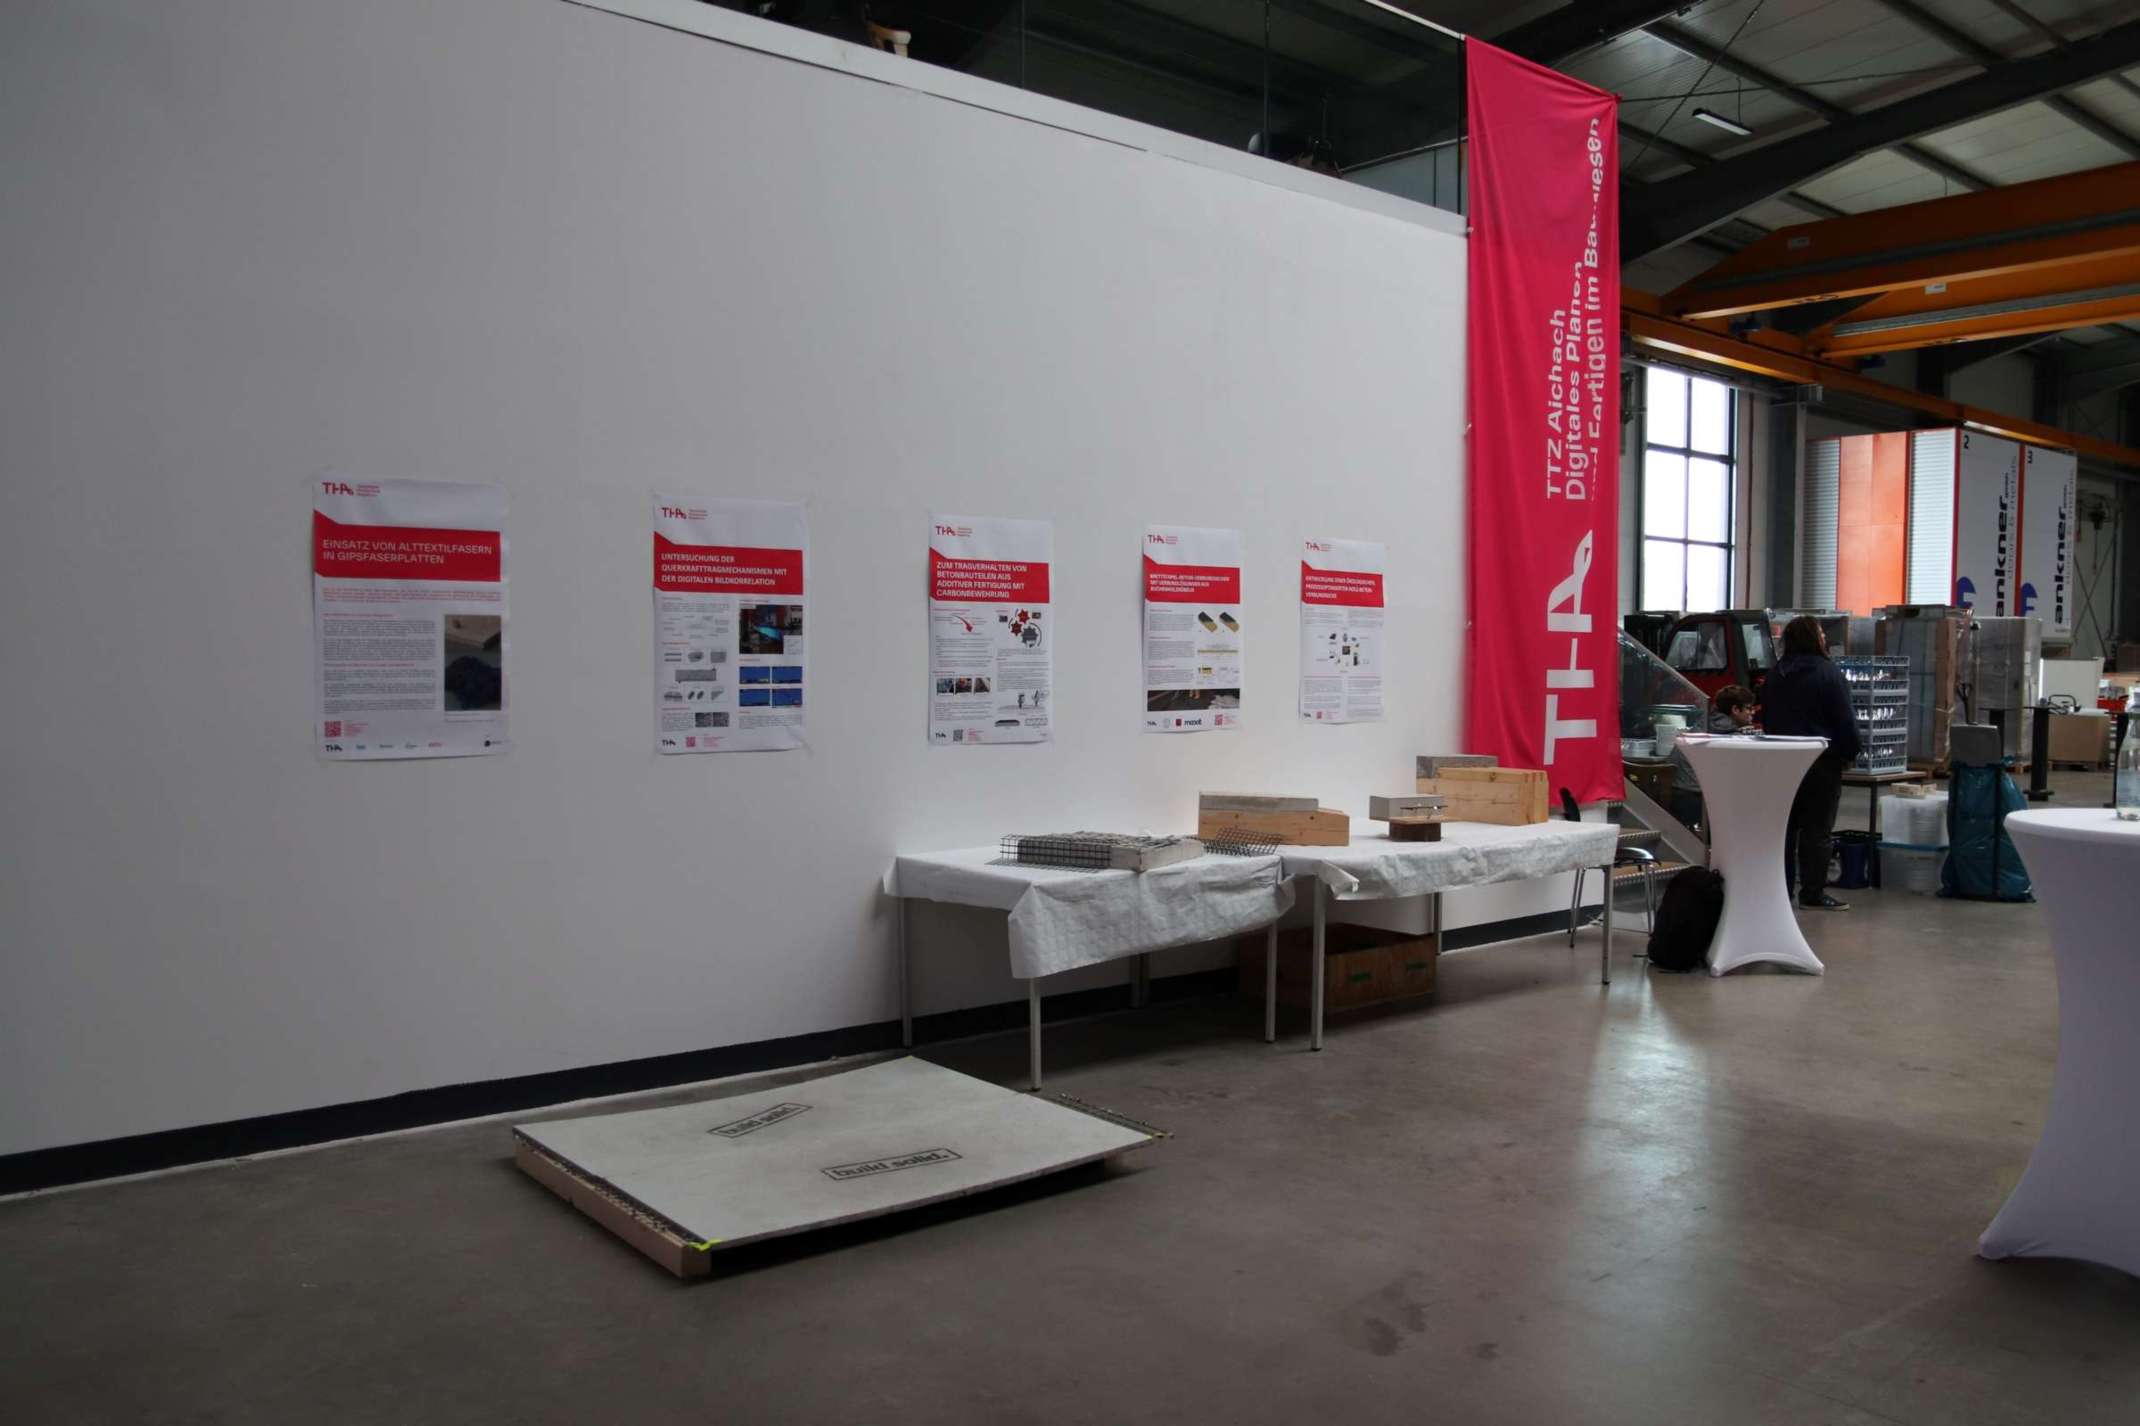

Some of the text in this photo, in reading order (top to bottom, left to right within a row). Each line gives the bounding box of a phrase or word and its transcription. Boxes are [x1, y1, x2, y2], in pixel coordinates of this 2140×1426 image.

[1584, 276, 1600, 311] im
[1565, 261, 1589, 500] Digitales Planen
[1546, 309, 1566, 500] TTZ Aichach
[1963, 436, 1970, 450] 2
[323, 539, 492, 555] EINSATZ VON ALTTEXTILFASERN
[323, 551, 444, 564] IN GIPSFASERPLATTEN
[661, 553, 735, 563] UNTERSUCHUNG DER
[661, 564, 773, 575] QUERKRAFTTRAGMECHANISMEN
[661, 575, 776, 586] DER DIGITALEN BILDKORRELATION
[1543, 529, 1597, 765] THA
[831, 1152, 950, 1177] build solid.
